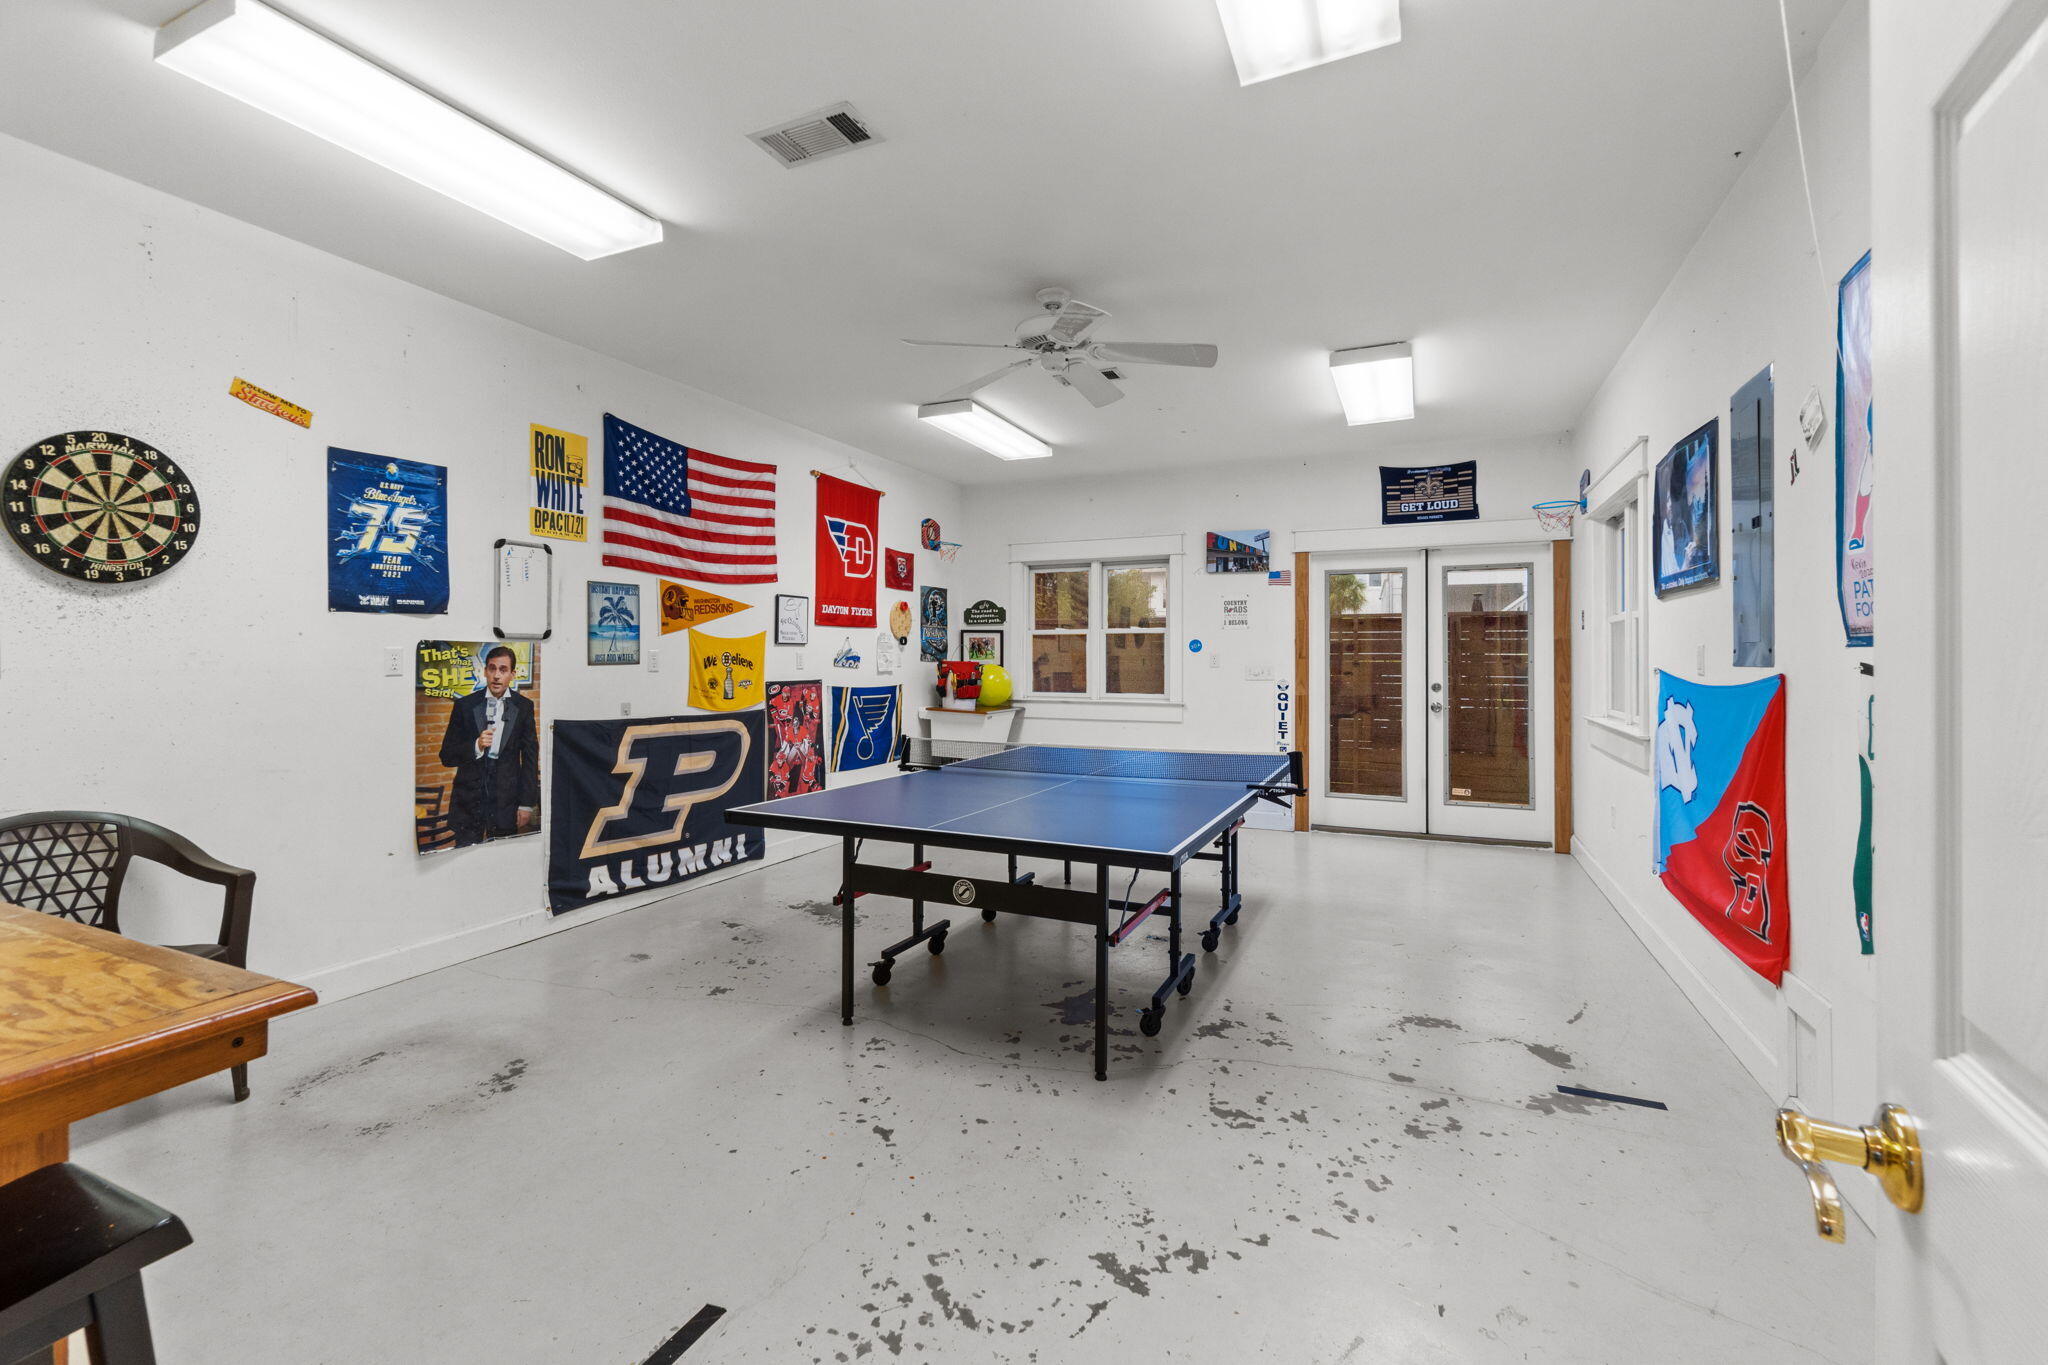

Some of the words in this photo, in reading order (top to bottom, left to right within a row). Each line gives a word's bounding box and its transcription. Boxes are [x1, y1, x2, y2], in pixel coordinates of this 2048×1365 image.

[240, 380, 278, 400] FOLLOW
[280, 399, 293, 408] ME
[296, 406, 307, 415] TO
[67, 434, 76, 444] 5
[91, 432, 107, 443] 20
[123, 437, 130, 447] 1
[39, 445, 56, 456] 12
[143, 450, 158, 460] 18
[535, 430, 565, 474] RON
[24, 459, 35, 470] 9
[166, 465, 175, 474] 4
[10, 479, 27, 490] 14
[177, 483, 191, 493] 13
[390, 483, 404, 491] NAVY
[363, 487, 388, 501] Blue
[388, 491, 417, 506] Angels
[535, 469, 584, 515] WHITE
[9, 501, 25, 512] 11
[186, 503, 195, 513] 6
[1401, 502, 1424, 512] GET
[1427, 499, 1459, 511] LOUD
[534, 509, 563, 532] DPAC
[20, 523, 31, 534] 8
[182, 523, 196, 533] 10
[350, 503, 427, 553] 75
[33, 543, 50, 554] 16
[174, 540, 187, 550] 15
[60, 558, 71, 568] 7
[161, 555, 170, 565] 2
[382, 555, 402, 565] YEAR
[90, 561, 144, 571] KINGSTON
[139, 567, 153, 576] 17
[371, 563, 412, 572] ANNIVERSARY
[84, 569, 100, 579] 19
[115, 571, 124, 581] 3
[694, 603, 734, 615] REDSKINS
[822, 604, 849, 615] DAYTON
[851, 606, 873, 617] FLYERS
[420, 646, 469, 663] That's
[449, 658, 472, 666] what
[703, 655, 718, 669] We
[421, 666, 475, 688] SHE
[424, 688, 455, 699] said!
[1277, 692, 1289, 739] QUIET
[579, 719, 751, 860] P
[586, 833, 748, 898] ALUMNI
